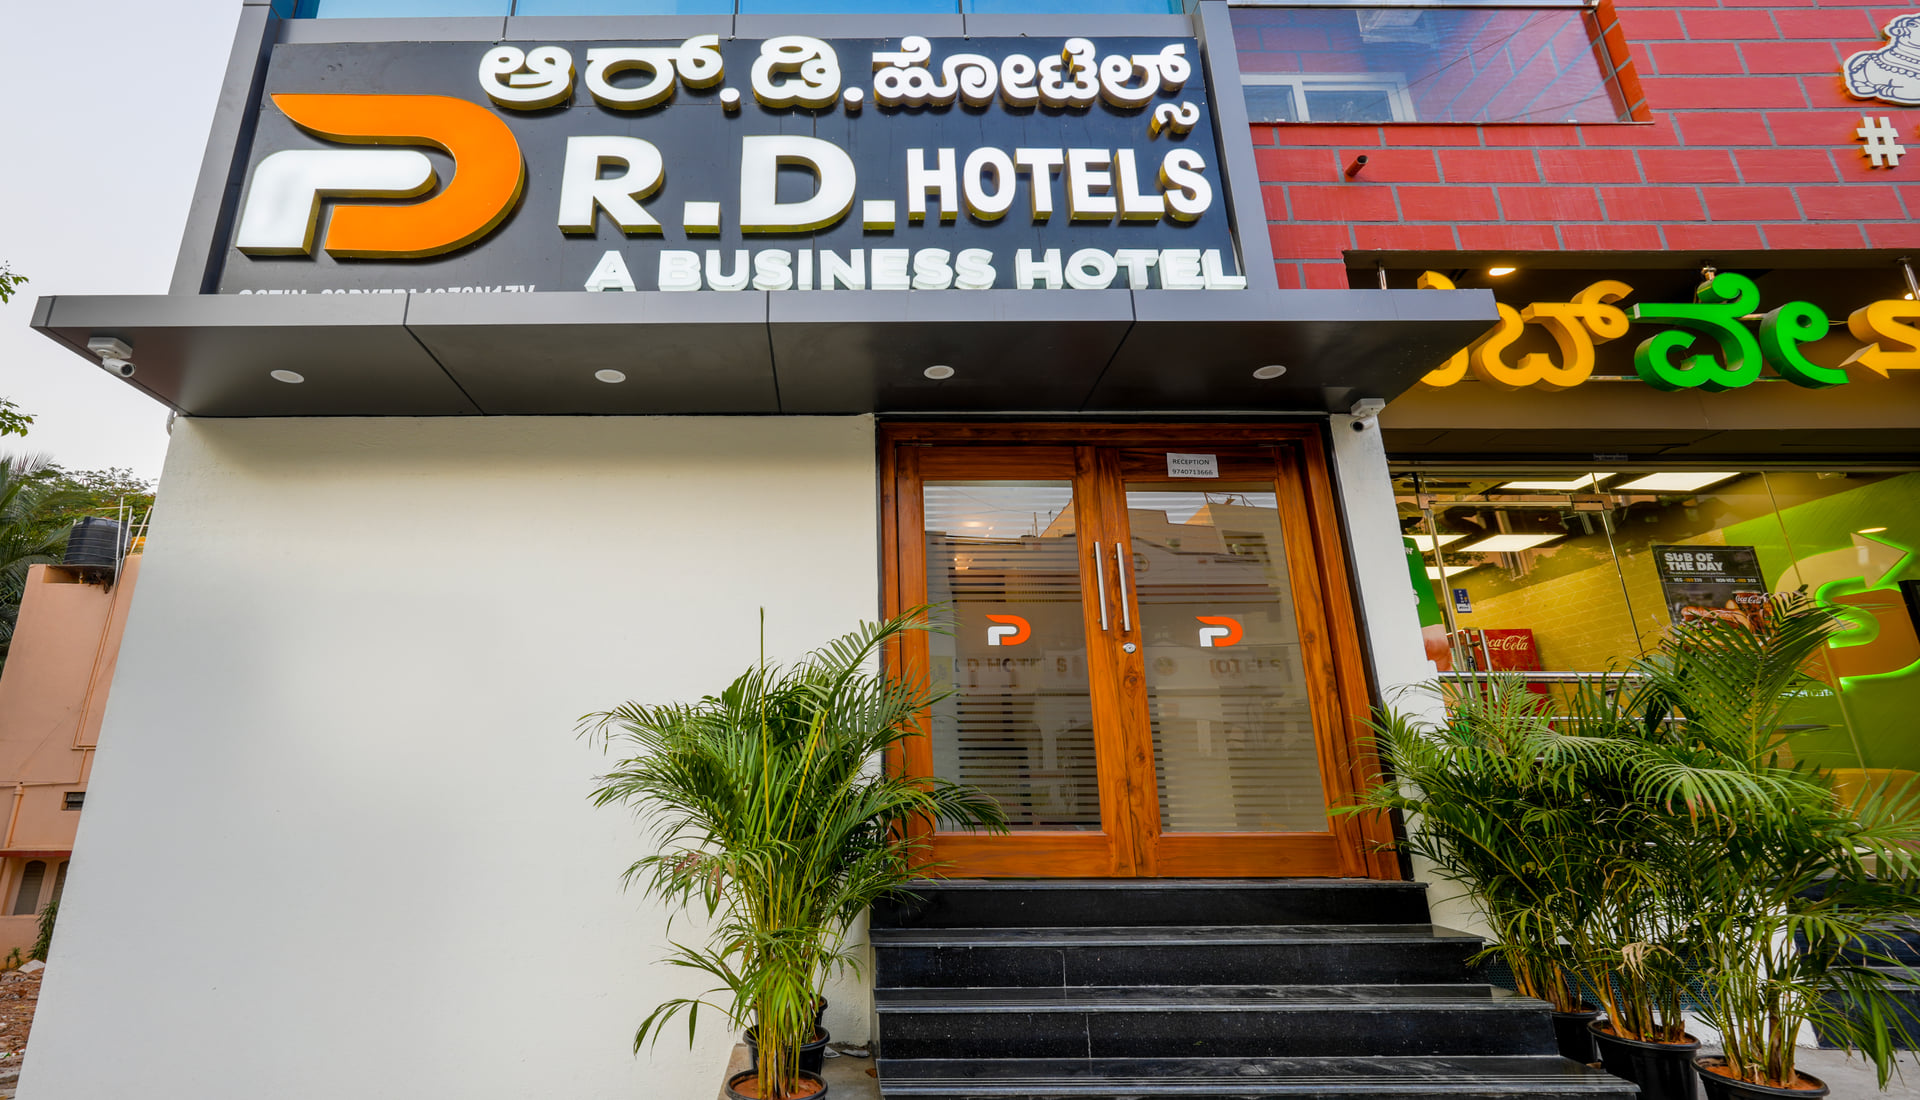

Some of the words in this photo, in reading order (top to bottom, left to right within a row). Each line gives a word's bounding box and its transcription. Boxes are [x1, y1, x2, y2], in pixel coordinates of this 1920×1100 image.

[907, 147, 1212, 222] HOTELS
[584, 250, 637, 292] A
[657, 248, 997, 291] BUSINESS
[1015, 248, 1247, 291] HOTEL
[1664, 552, 1694, 562] SUB
[1695, 553, 1714, 562] OF
[1666, 561, 1695, 571] THE
[1696, 562, 1724, 571] DAY
[1478, 635, 1529, 651] ca-Cola
